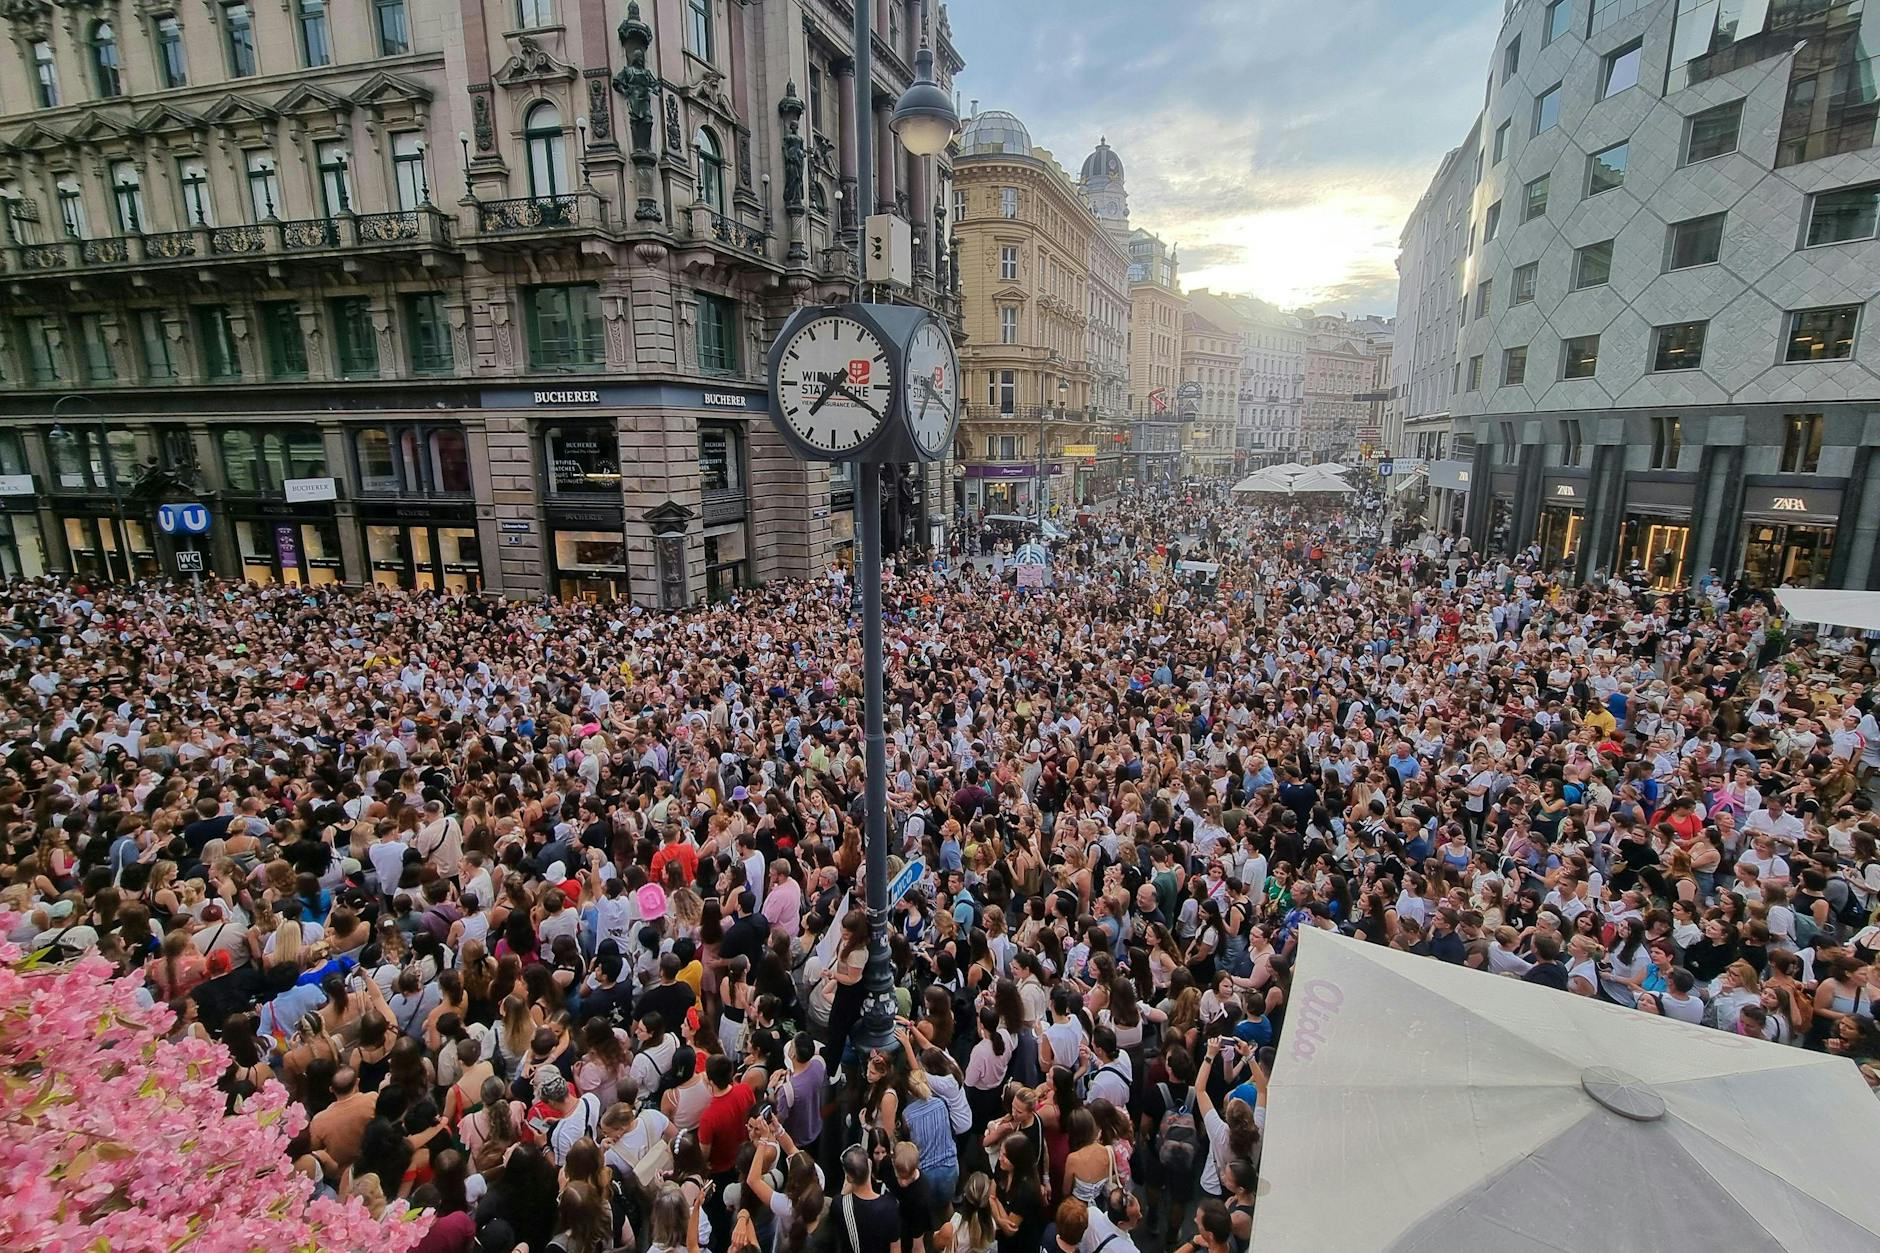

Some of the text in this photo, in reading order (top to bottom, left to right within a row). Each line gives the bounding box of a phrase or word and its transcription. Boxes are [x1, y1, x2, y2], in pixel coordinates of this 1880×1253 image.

[802, 371, 847, 382] WINE
[534, 391, 599, 404] BUCHERER
[704, 393, 747, 407] BUCHERER
[1381, 464, 1393, 476] U
[292, 484, 329, 492] BUCHERER
[1773, 497, 1808, 512] ZARA
[159, 510, 175, 531] U
[183, 509, 207, 531] U
[179, 553, 200, 563] WC
